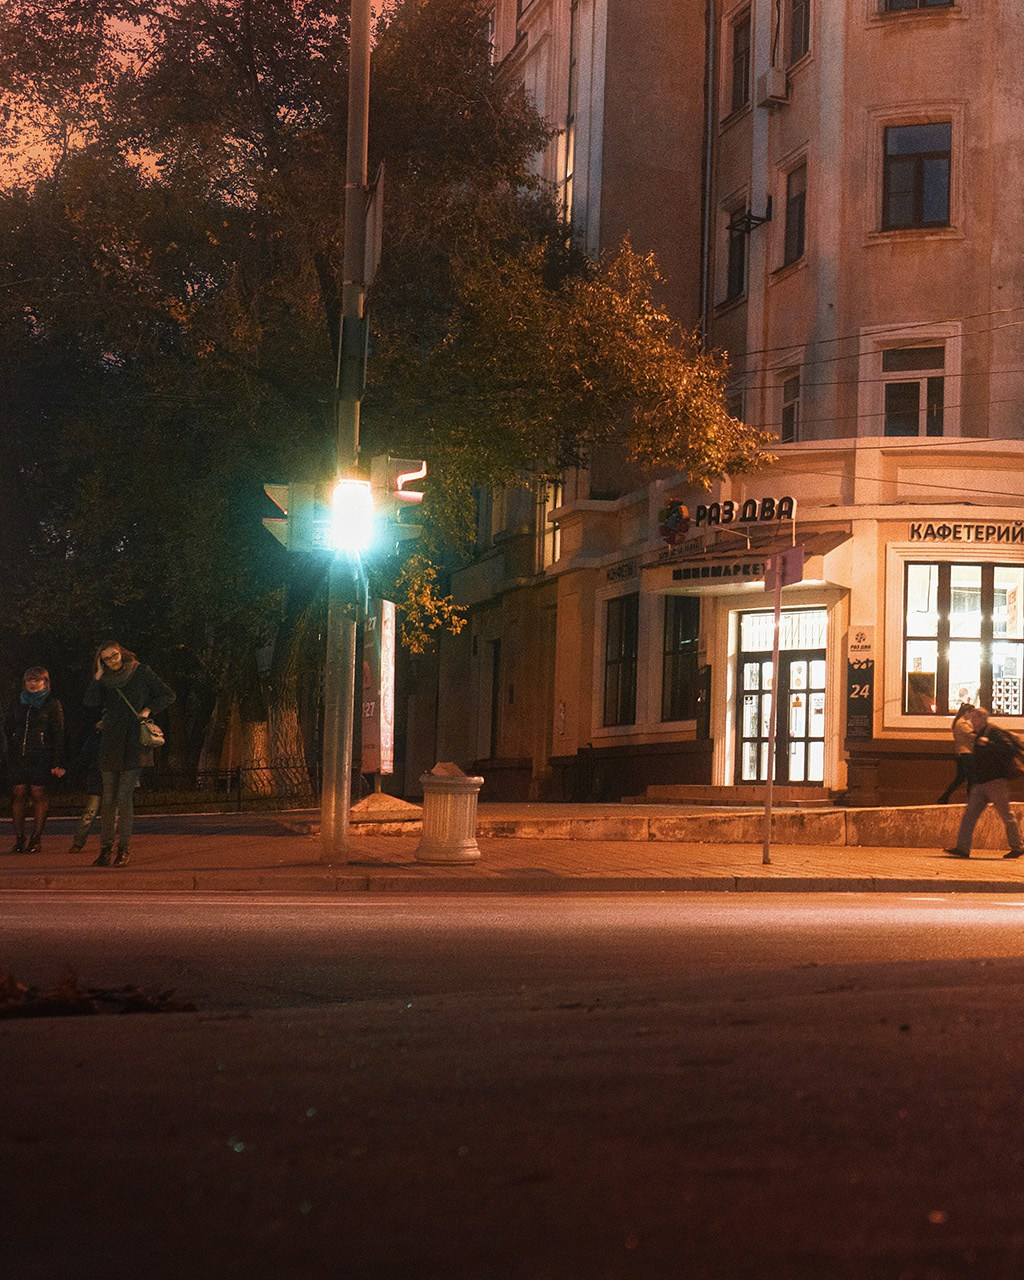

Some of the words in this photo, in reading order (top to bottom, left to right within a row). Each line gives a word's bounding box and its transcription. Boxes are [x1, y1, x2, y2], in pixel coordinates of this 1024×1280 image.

[696, 500, 737, 527] РАЗ
[740, 496, 796, 523] ДВА
[910, 521, 1024, 543] КАФЕТЕРИЙ
[850, 683, 870, 699] 24
